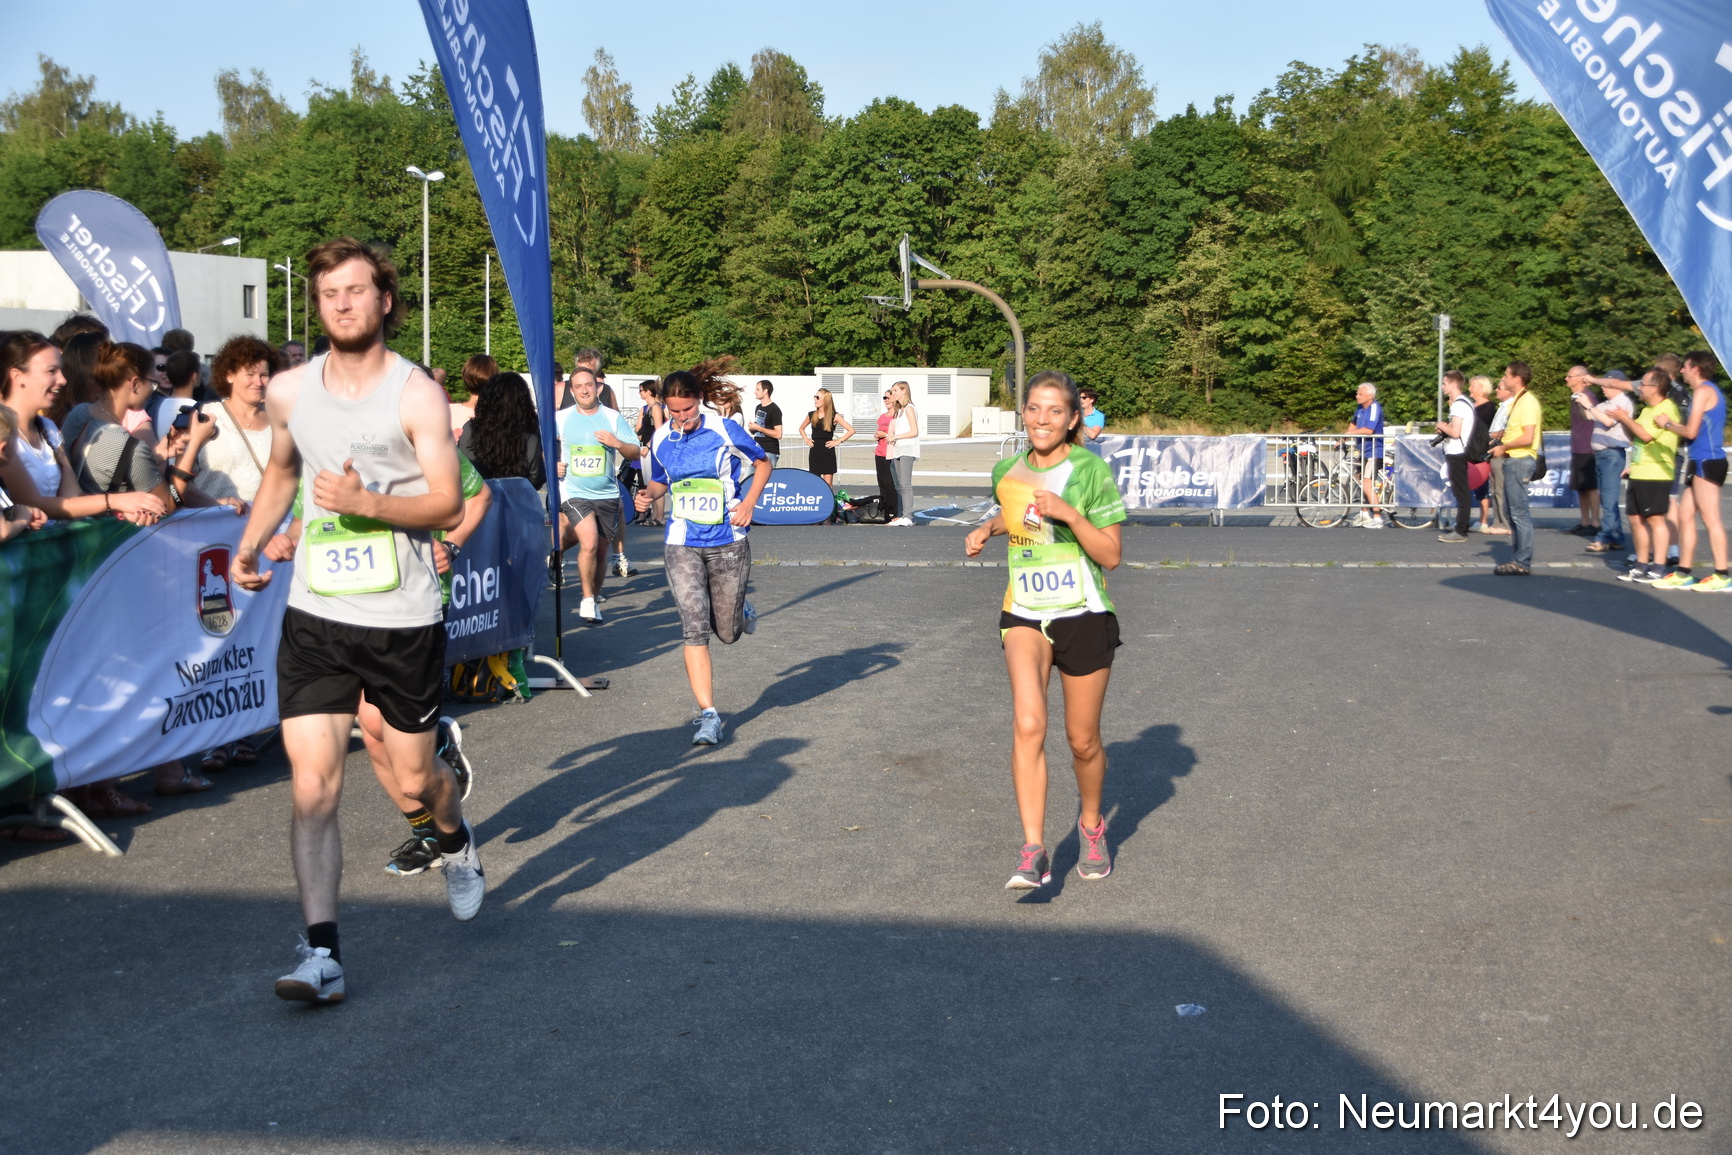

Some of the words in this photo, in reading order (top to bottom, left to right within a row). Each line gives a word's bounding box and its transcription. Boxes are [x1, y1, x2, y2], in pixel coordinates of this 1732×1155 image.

[573, 458, 602, 468] 1427
[1117, 466, 1224, 486] Fischer
[763, 492, 823, 506] Fischer
[1127, 488, 1213, 497] AUTOMOBILE
[678, 496, 719, 511] 1120
[326, 545, 375, 573] 351
[1019, 569, 1076, 592] 1004
[208, 615, 228, 629] 1628
